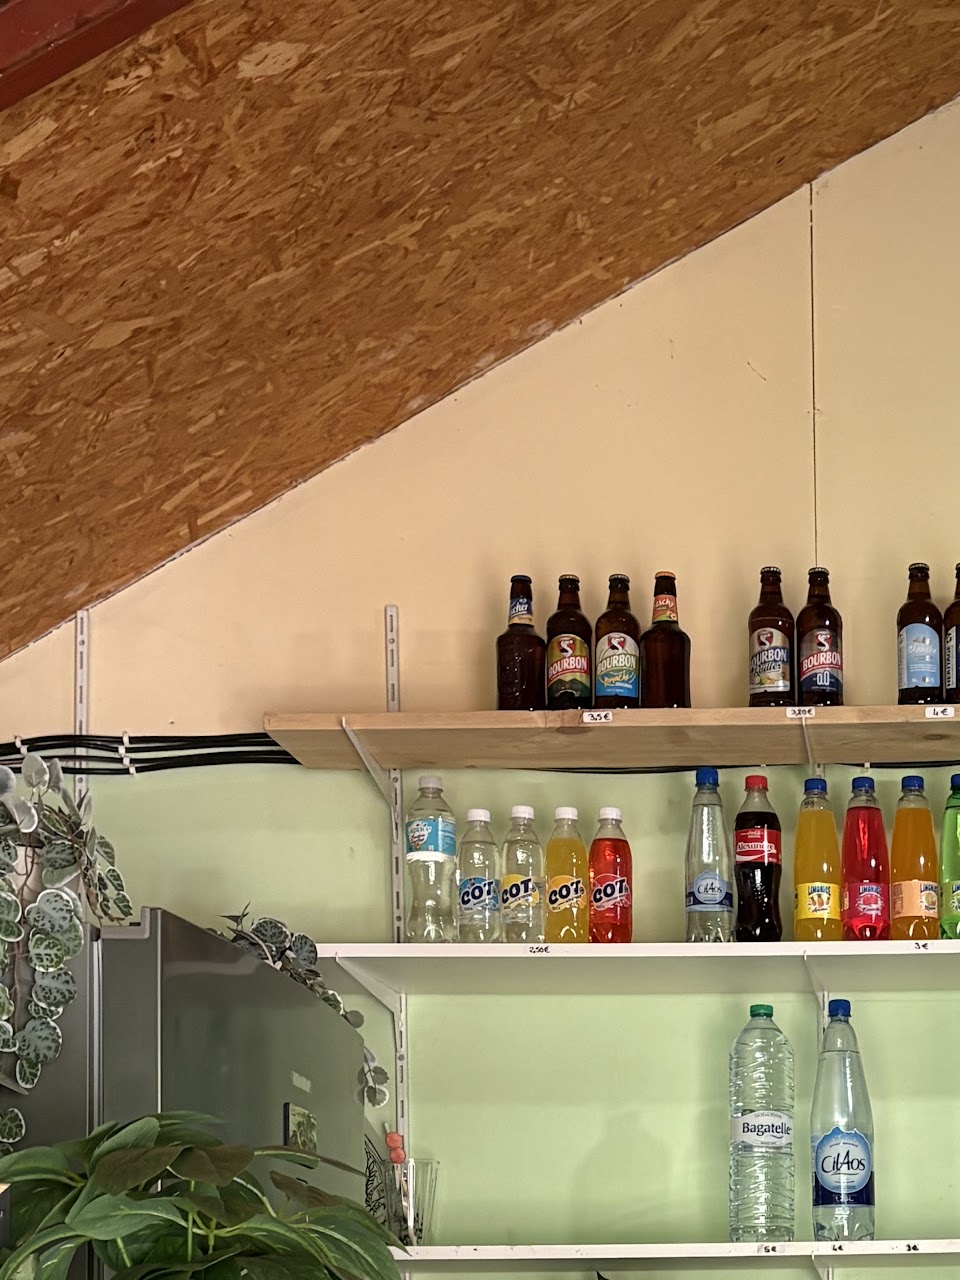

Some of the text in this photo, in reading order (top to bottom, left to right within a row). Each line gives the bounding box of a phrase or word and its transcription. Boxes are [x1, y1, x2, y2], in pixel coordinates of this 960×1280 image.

[548, 656, 588, 678] BOURBON
[802, 651, 841, 672] BOURBON
[461, 879, 495, 906] COT
[501, 878, 533, 905] COT
[548, 878, 582, 905] COT
[592, 878, 626, 904] COT
[741, 1121, 791, 1139] Bagatelle
